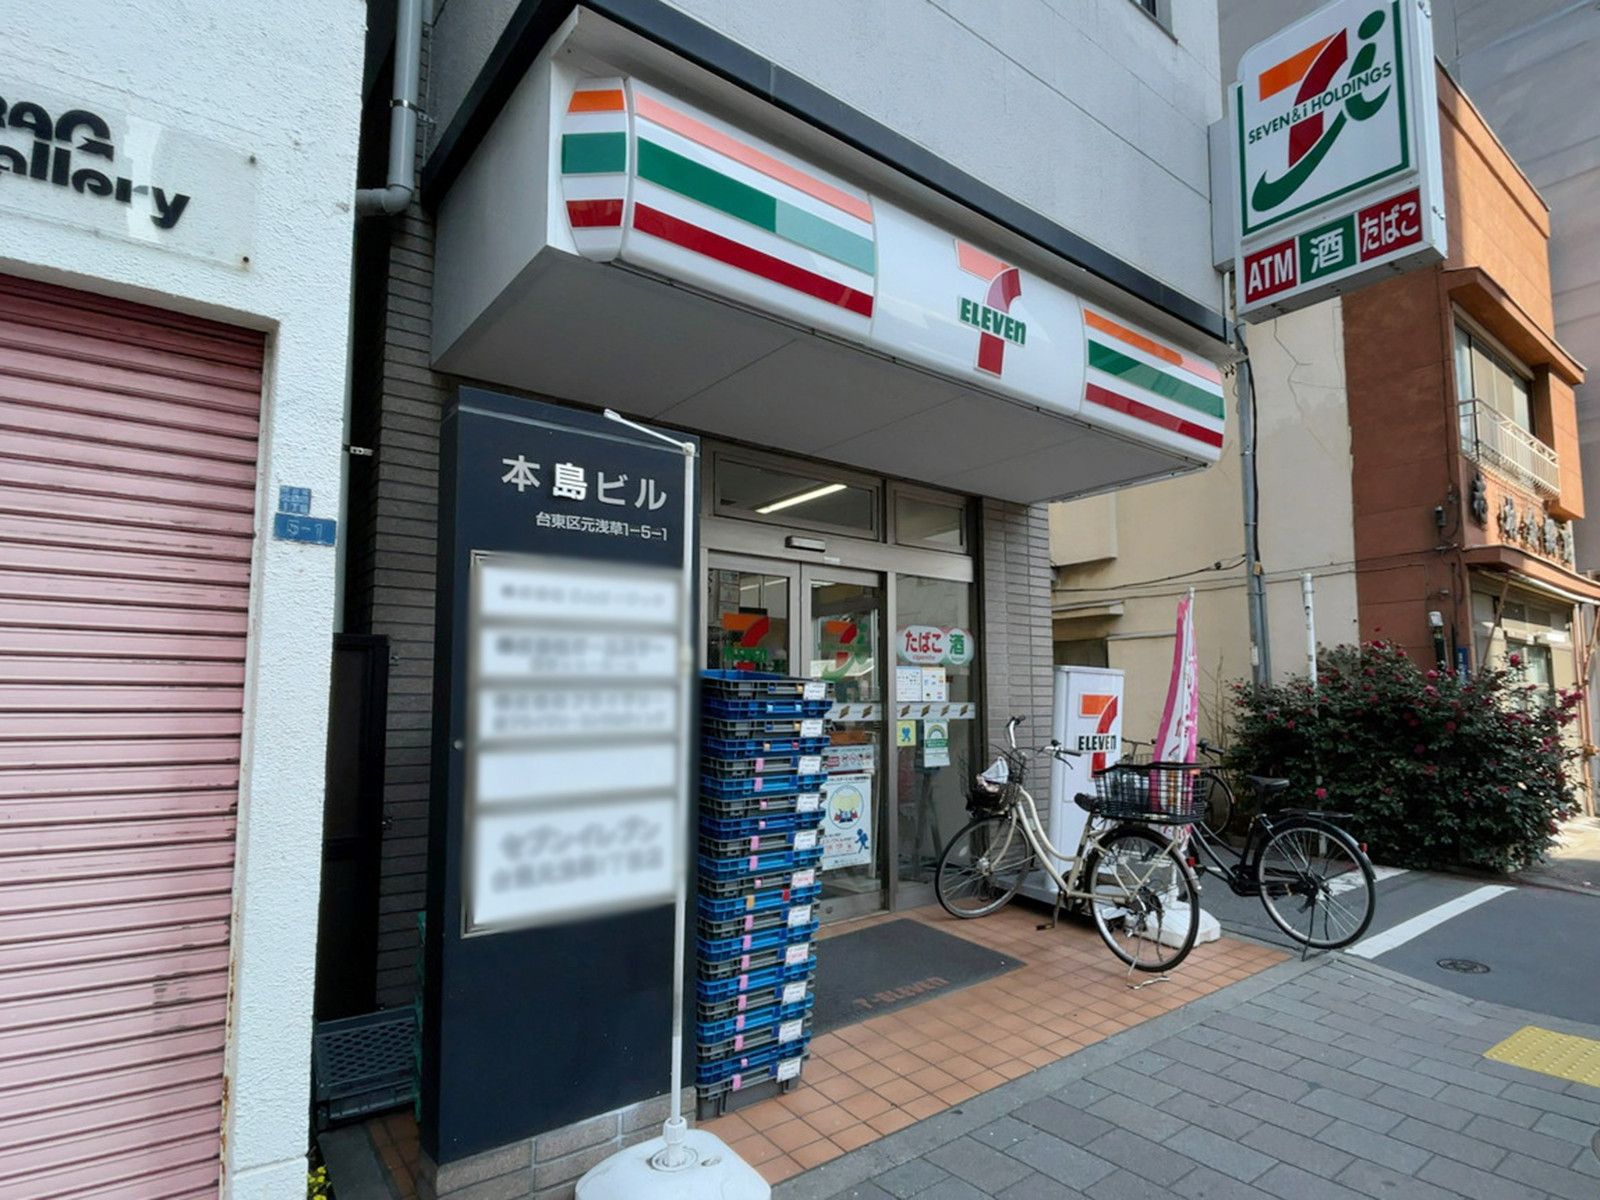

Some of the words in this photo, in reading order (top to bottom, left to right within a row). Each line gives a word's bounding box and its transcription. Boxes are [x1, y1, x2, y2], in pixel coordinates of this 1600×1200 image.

[1311, 61, 1392, 111] HOLDINGS
[0, 96, 114, 162] aG
[1310, 227, 1344, 274] 酒
[1361, 201, 1420, 254] たばこ
[1248, 248, 1293, 296] ATM
[501, 454, 667, 511] 本島ビル
[287, 519, 324, 540] 5-1
[905, 630, 943, 654] たばこ
[949, 633, 965, 656] 酒
